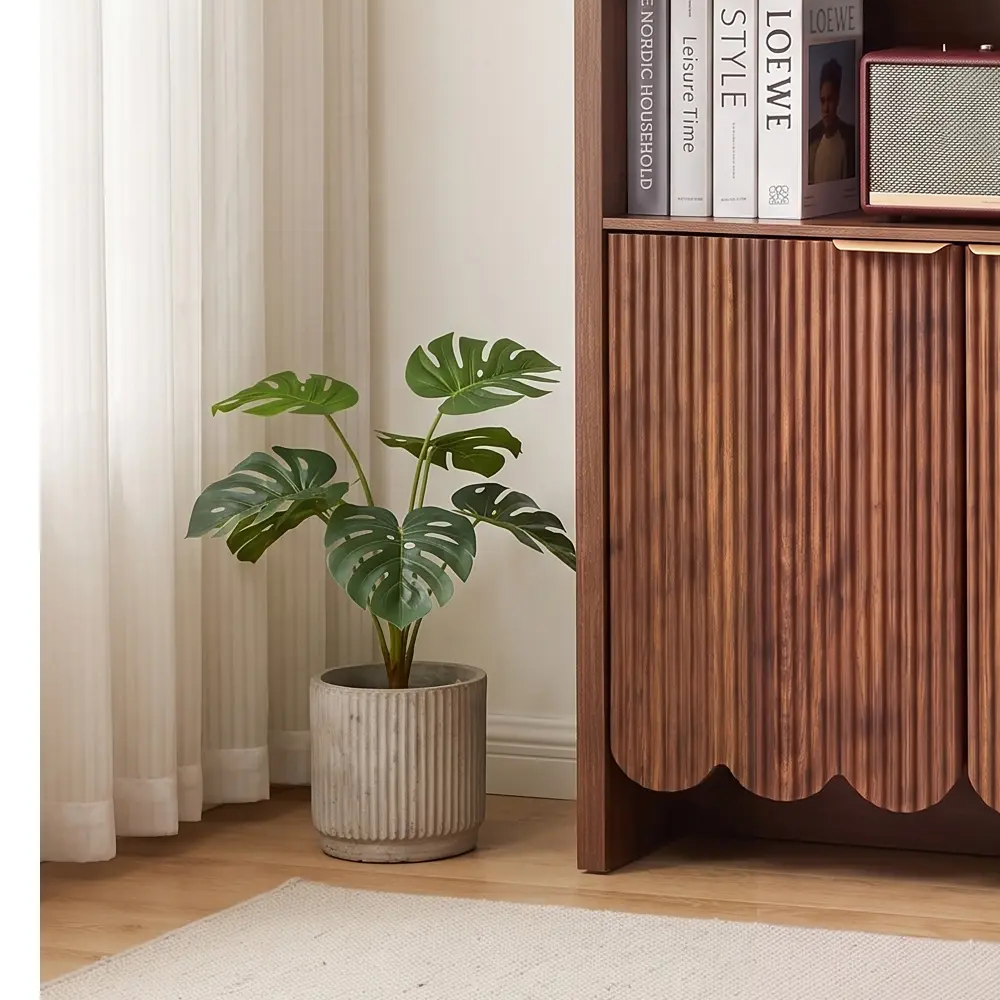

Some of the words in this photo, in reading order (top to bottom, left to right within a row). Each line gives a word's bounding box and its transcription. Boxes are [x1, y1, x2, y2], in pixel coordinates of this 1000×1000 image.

[640, 10, 654, 80] NORDIC
[809, 5, 856, 34] LOEWE
[682, 36, 698, 103] Leisure
[720, 8, 747, 108] STYLE
[765, 9, 792, 131] LOEWE
[639, 84, 654, 190] HOUSEHOLD
[682, 107, 699, 154] Time
